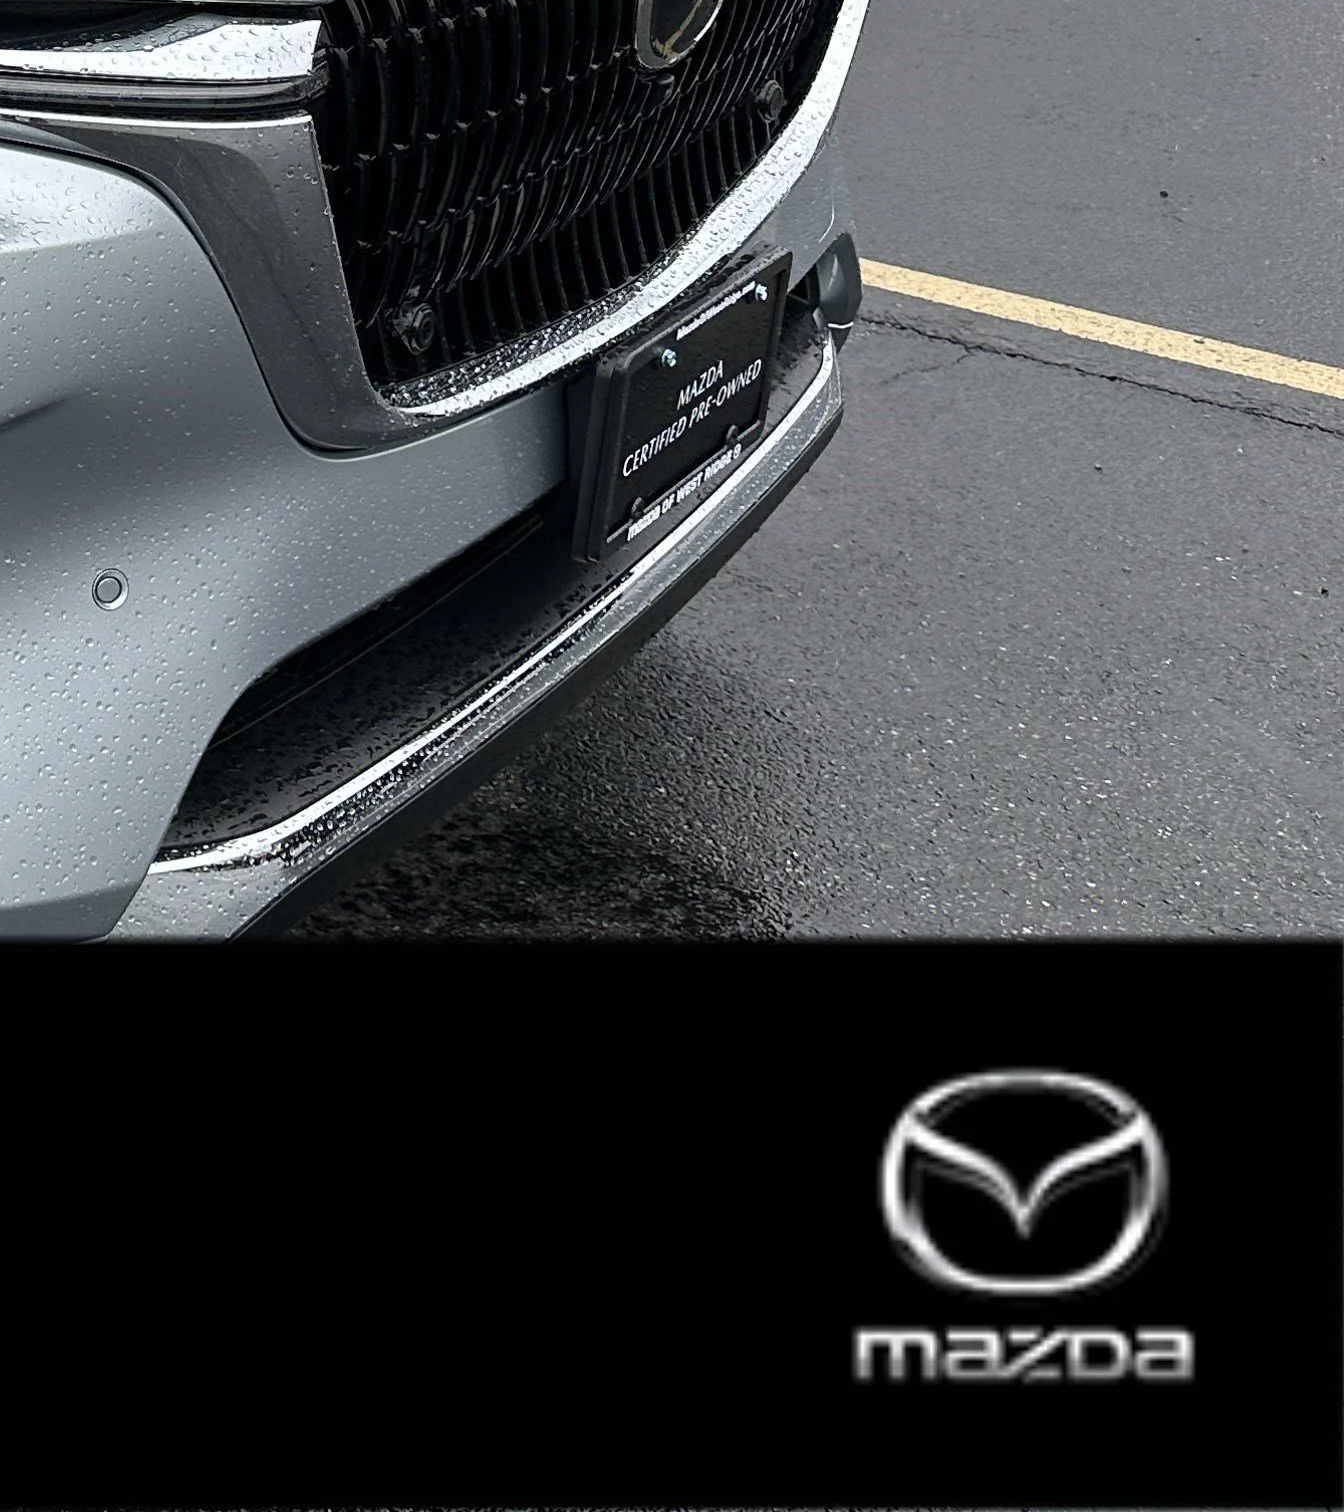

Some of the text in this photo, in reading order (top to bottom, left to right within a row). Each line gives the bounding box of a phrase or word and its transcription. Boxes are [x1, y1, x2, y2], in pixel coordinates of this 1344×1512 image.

[622, 358, 762, 478] CERTIFIED PRE-OWNED
[677, 359, 724, 411] MAZDA
